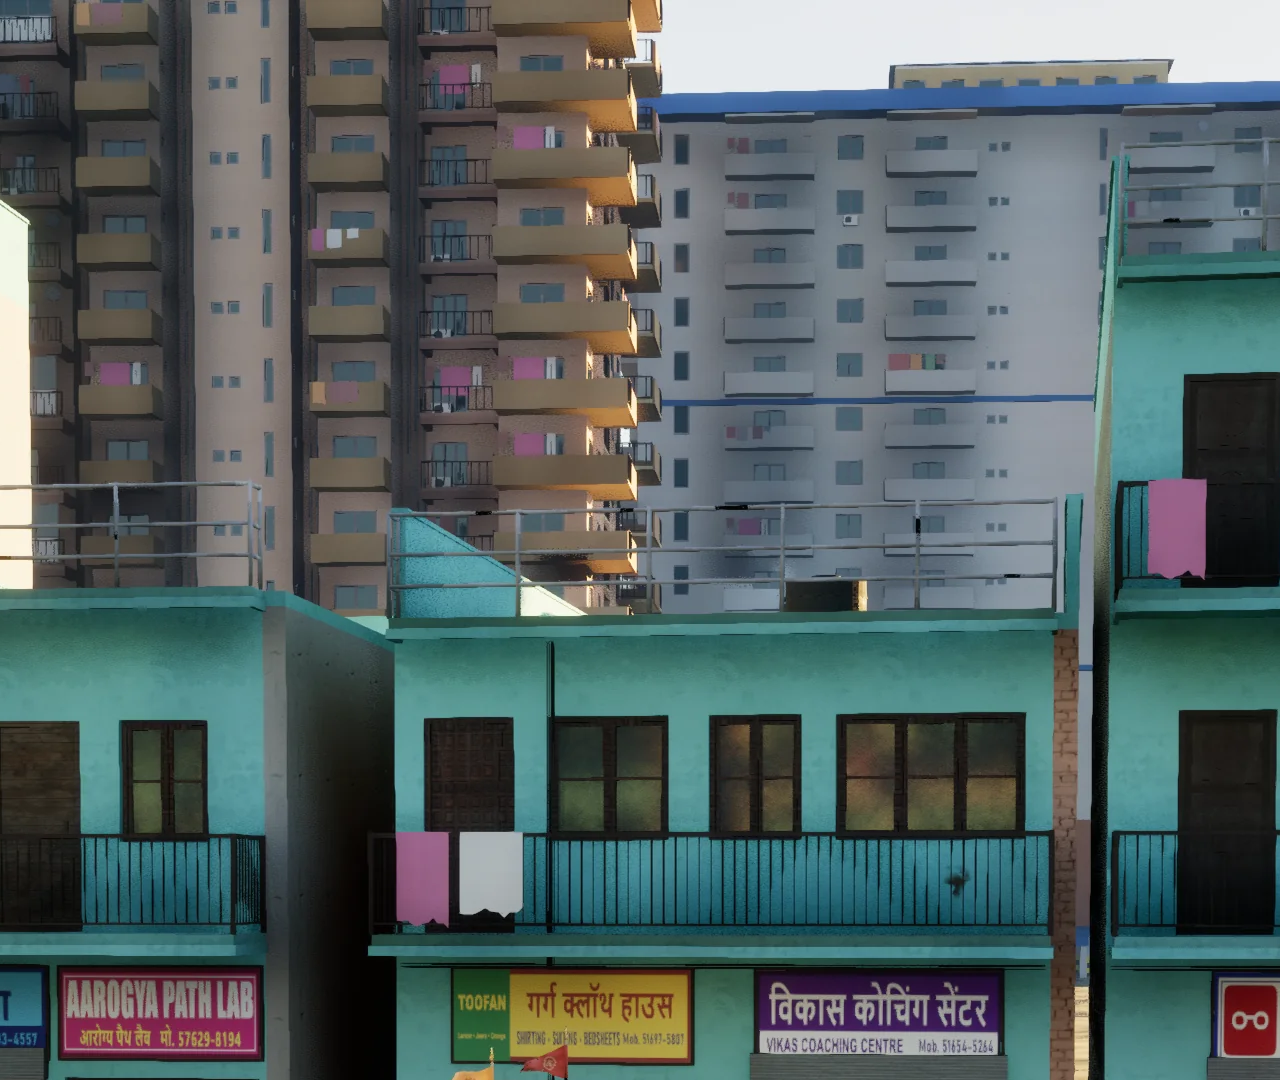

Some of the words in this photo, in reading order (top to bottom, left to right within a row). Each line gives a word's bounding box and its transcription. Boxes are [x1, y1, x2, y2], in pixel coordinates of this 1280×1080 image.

[66, 979, 160, 1020] AAROGYA
[162, 980, 213, 1020] PATH
[216, 980, 255, 1020] LAB
[457, 993, 508, 1012] TOOFAN
[526, 982, 557, 1019] गर्ग
[562, 982, 615, 1019] क्लॉथ
[619, 993, 674, 1023] हाउस
[768, 981, 848, 1027] विकास
[852, 981, 931, 1027] कोचिंग
[935, 981, 990, 1028] सेंटर
[79, 1023, 114, 1047] आरोग्य
[116, 1023, 132, 1047] पैथ
[159, 1024, 175, 1047] मो.
[178, 1030, 242, 1048] 57629-8194
[516, 1031, 547, 1046] SHIRTING
[583, 1031, 621, 1046] BEDSHEETS
[622, 1032, 640, 1046] Mob.
[766, 1037, 799, 1053] VIKAS
[801, 1037, 858, 1053] COACHING
[860, 1038, 904, 1054] CENTRE
[918, 1039, 940, 1053] Mob.
